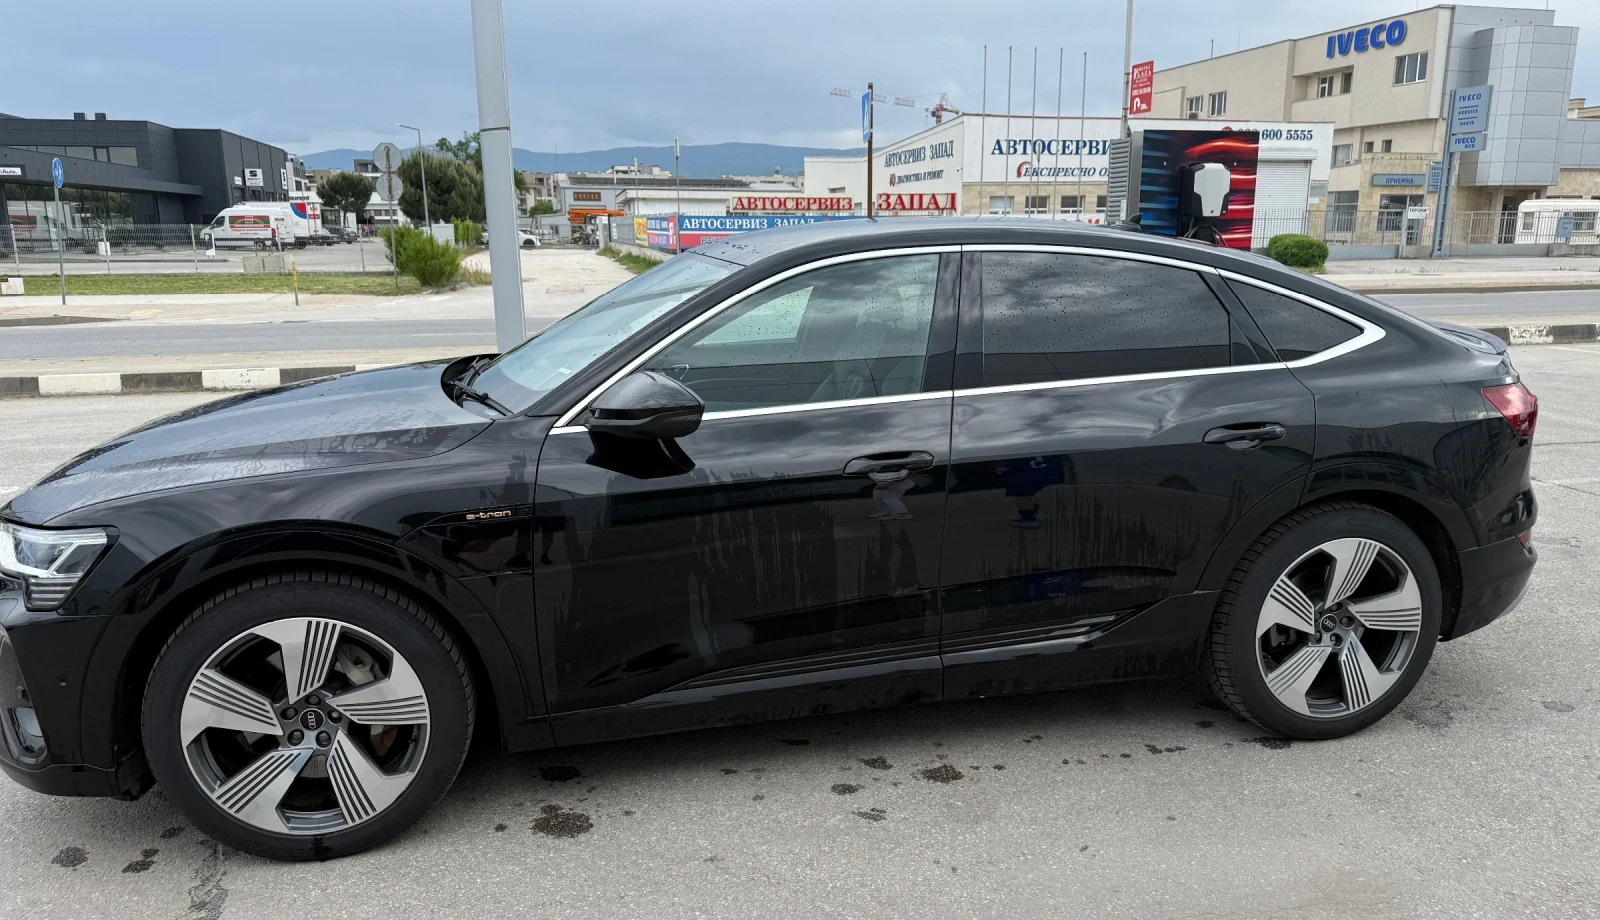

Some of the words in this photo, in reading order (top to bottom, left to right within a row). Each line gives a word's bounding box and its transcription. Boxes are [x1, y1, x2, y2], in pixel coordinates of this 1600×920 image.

[1326, 19, 1407, 58] IVECO
[1458, 93, 1482, 102] IVECO
[1458, 108, 1479, 116] SERVICE
[1261, 128, 1283, 141] 600
[1285, 129, 1314, 141] 5555
[1454, 136, 1476, 145] IVECO
[990, 138, 1110, 156] АВТОСЕРВИ
[884, 145, 927, 168] АВТОСЕРВИЗ
[929, 139, 954, 160] ЗАПАД
[896, 172, 923, 184] ДИАГНОСТИКА
[927, 169, 944, 180] РЕМОНТ
[1023, 166, 1097, 177] ЕКСПРЕСНО
[1385, 177, 1414, 185] ПРИЕМНА
[733, 196, 853, 211] АВТОСЕРВИЗ
[878, 192, 958, 213] ЗАПАД
[682, 218, 768, 230] АВТОСЕРВИЗ
[465, 510, 512, 520] e-tron
